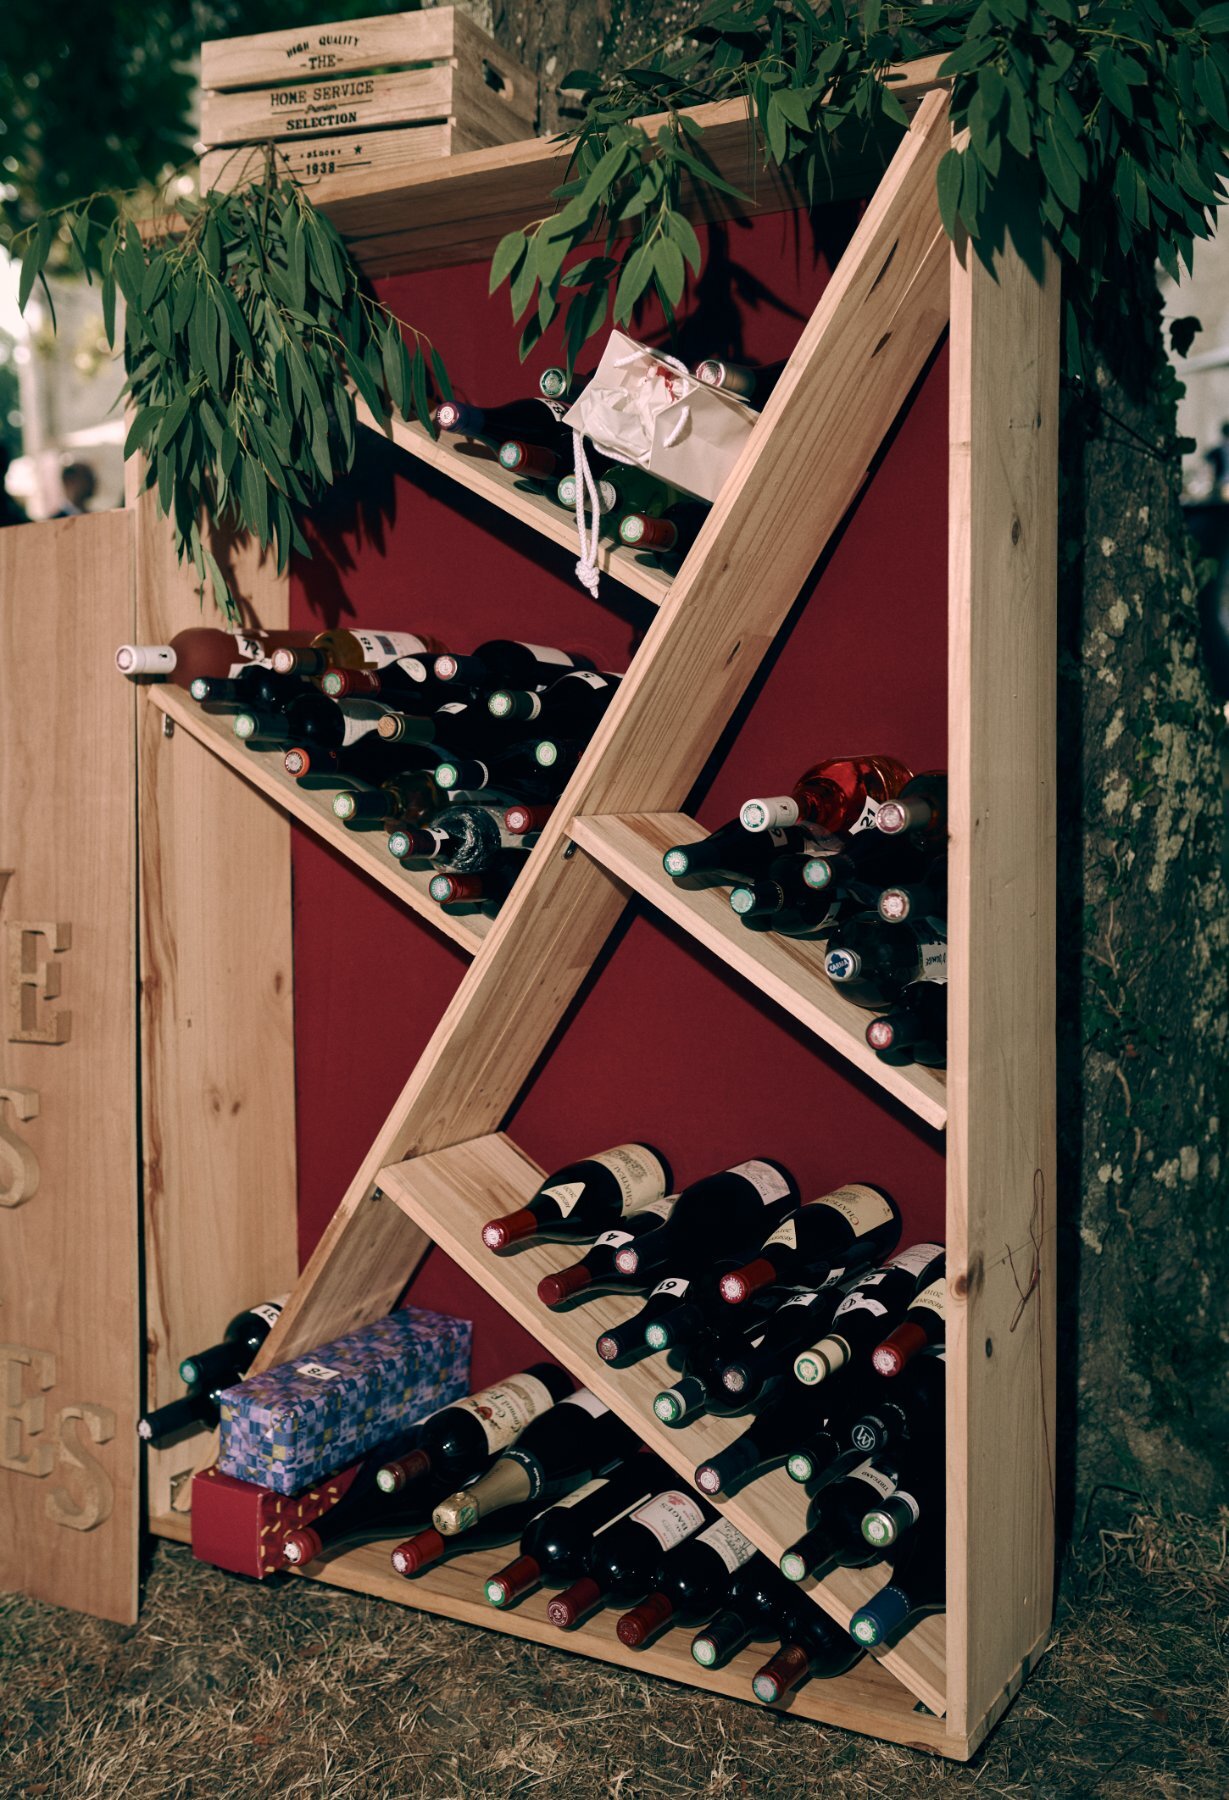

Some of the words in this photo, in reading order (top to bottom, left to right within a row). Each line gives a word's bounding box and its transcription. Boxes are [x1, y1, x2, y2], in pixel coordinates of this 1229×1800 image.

[286, 41, 309, 58] HIGH
[318, 35, 359, 46] QUALITY
[308, 54, 336, 70] THE
[270, 90, 307, 106] HOME
[312, 80, 374, 101] SERVICE
[286, 112, 357, 130] SELECTION
[306, 162, 335, 175] 1938
[860, 807, 877, 828] 21
[657, 1280, 678, 1292] 61
